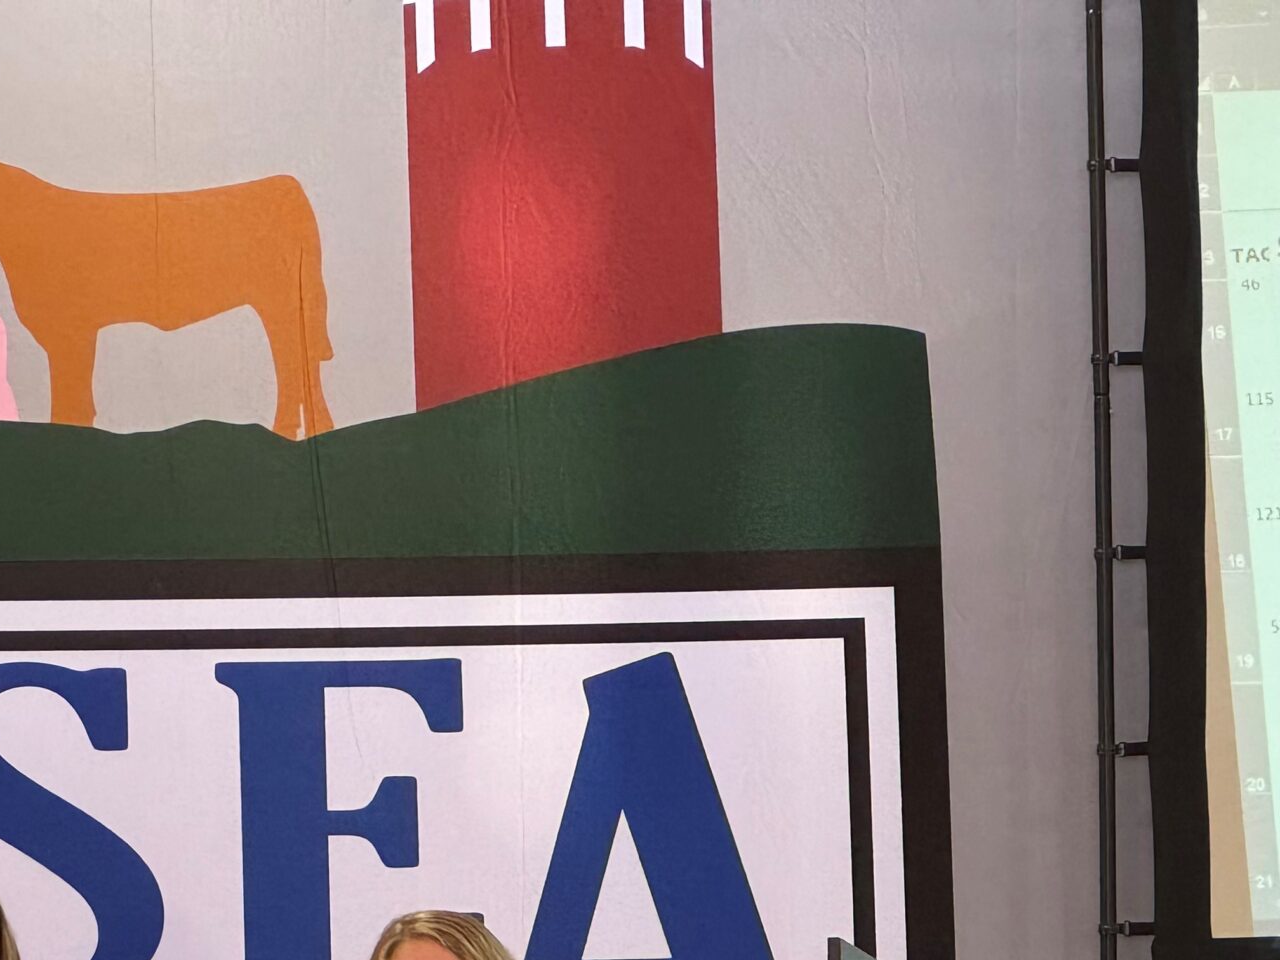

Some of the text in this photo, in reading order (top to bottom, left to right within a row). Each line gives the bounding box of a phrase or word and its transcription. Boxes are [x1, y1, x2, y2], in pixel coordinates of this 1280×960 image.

[1246, 392, 1275, 406] 115
[1215, 427, 1233, 441] 17
[1236, 653, 1255, 669] 19
[1246, 777, 1266, 792] 20
[1255, 874, 1273, 889] 21
